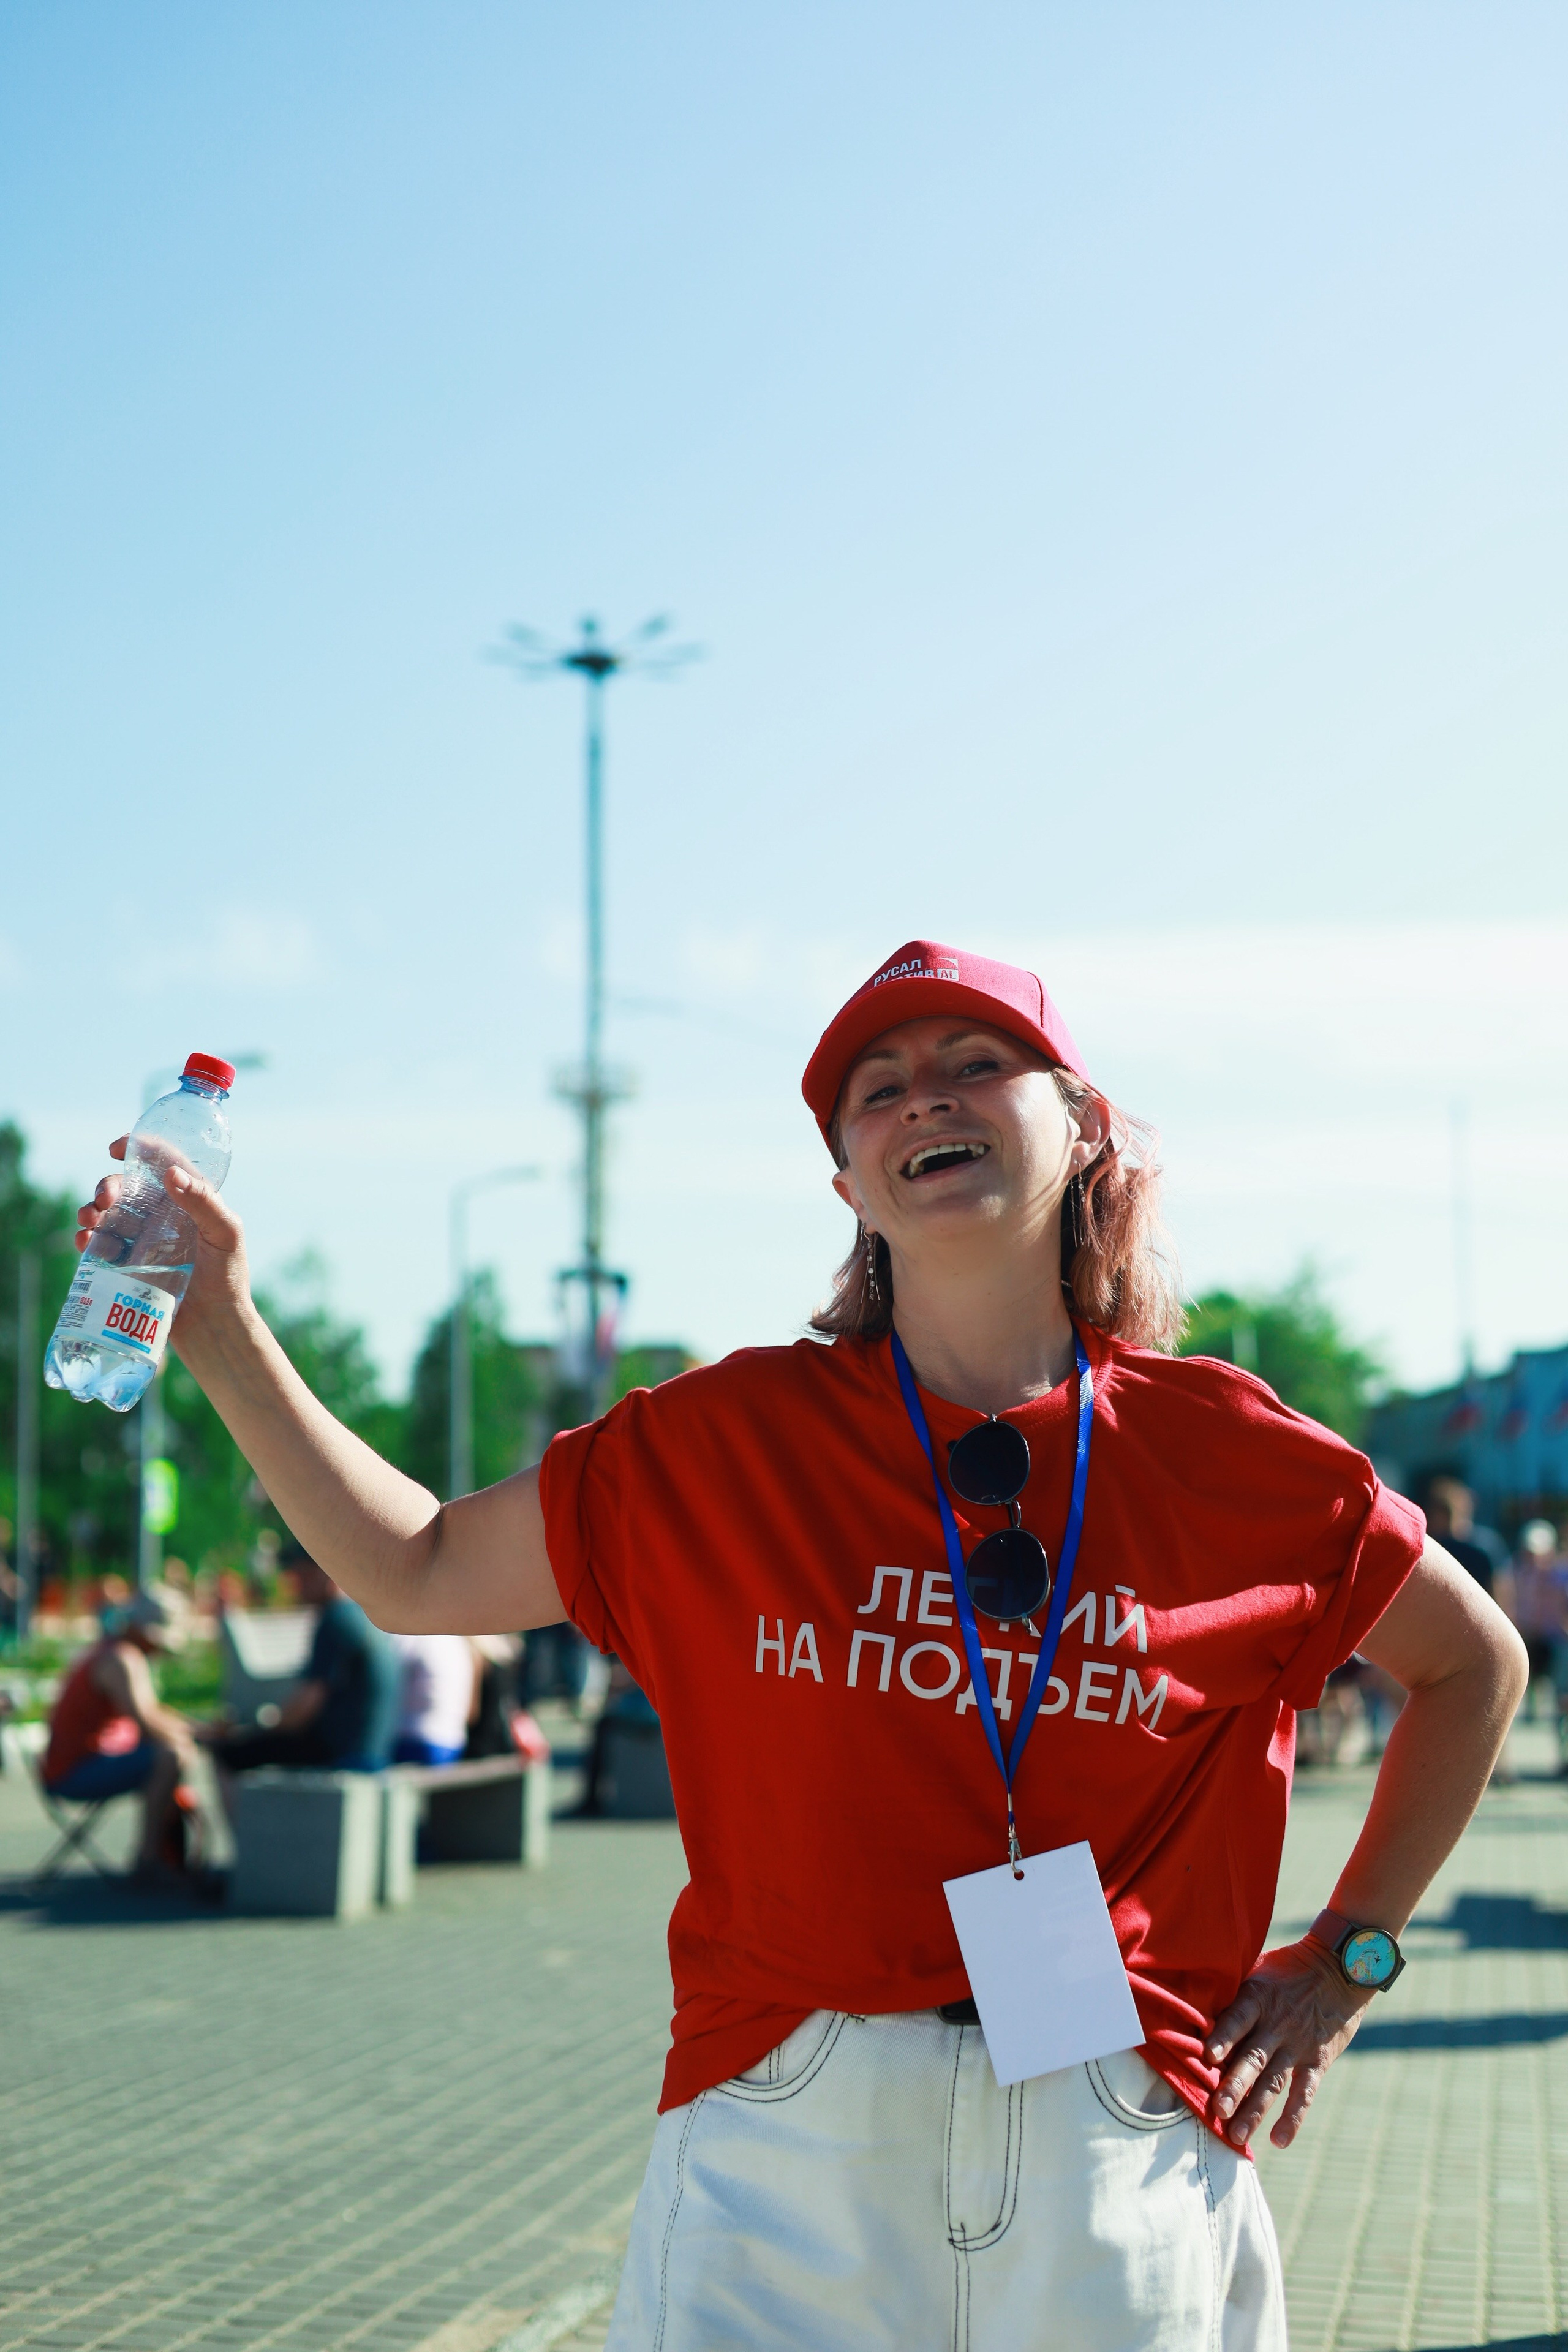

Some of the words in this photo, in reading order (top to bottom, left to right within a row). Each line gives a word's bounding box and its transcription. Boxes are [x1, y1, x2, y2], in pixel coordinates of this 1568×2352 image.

[873, 959, 921, 987] РУСАЛ
[105, 1302, 159, 1345] ВОДА
[113, 1292, 165, 1321] ГОРНАЯ
[755, 1615, 824, 1683] НА
